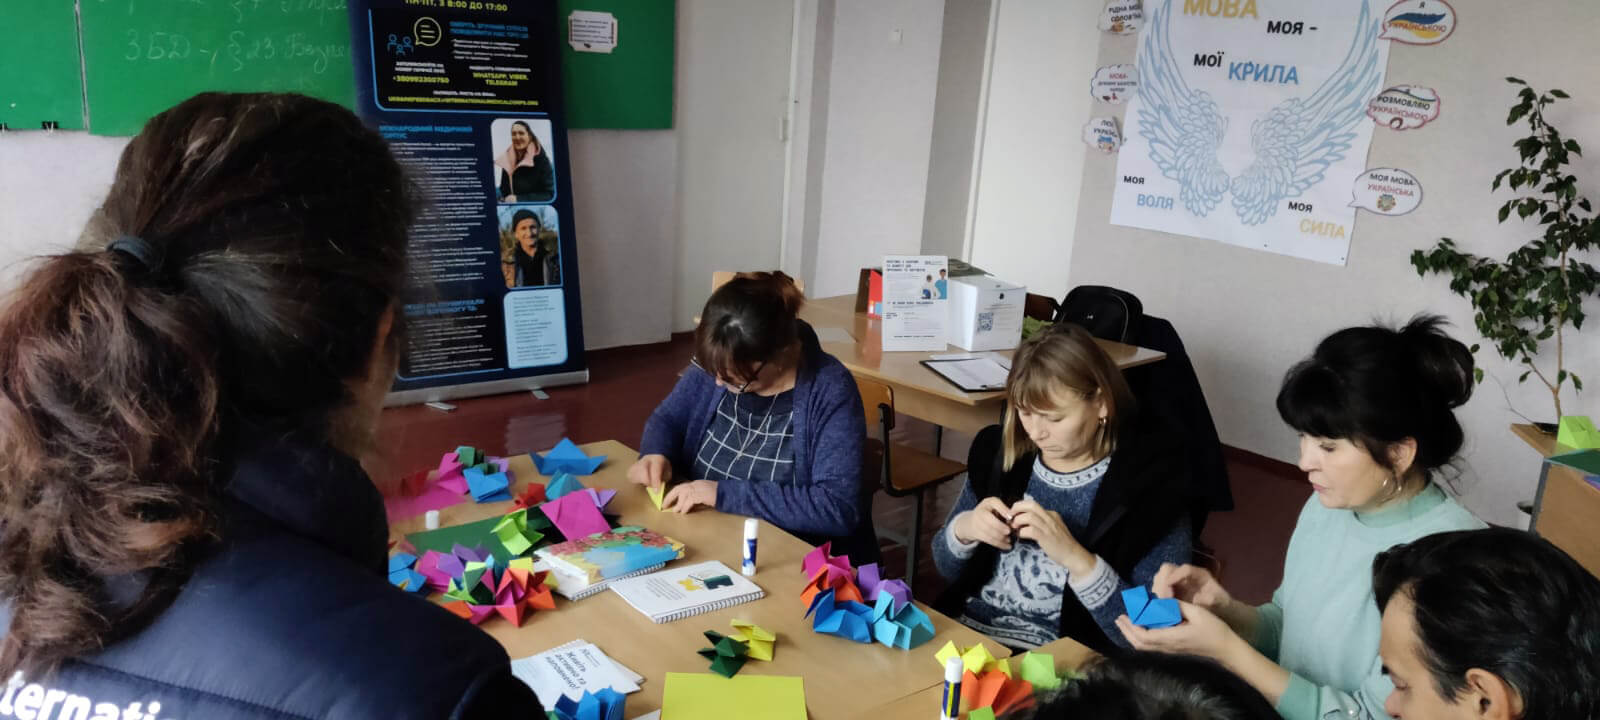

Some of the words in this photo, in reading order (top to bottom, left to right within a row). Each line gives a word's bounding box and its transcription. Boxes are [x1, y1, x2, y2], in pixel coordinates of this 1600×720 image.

[469, 2, 482, 10] ДО
[485, 3, 508, 11] 17:00
[1183, 0, 1259, 19] МОВА
[1267, 20, 1304, 35] МОЯ
[1194, 51, 1225, 67] МОЇ
[1229, 61, 1299, 85] КРИЛА
[1377, 95, 1431, 110] РОЗМОВЛЯЮ
[1124, 175, 1145, 185] МОЯ
[1370, 173, 1389, 181] МОЯ
[1367, 183, 1414, 196] УКРАЇНСЬКА
[1137, 193, 1174, 210] ВОЛЯ
[1288, 200, 1313, 213] МОЯ
[1299, 218, 1345, 239] СИЛА
